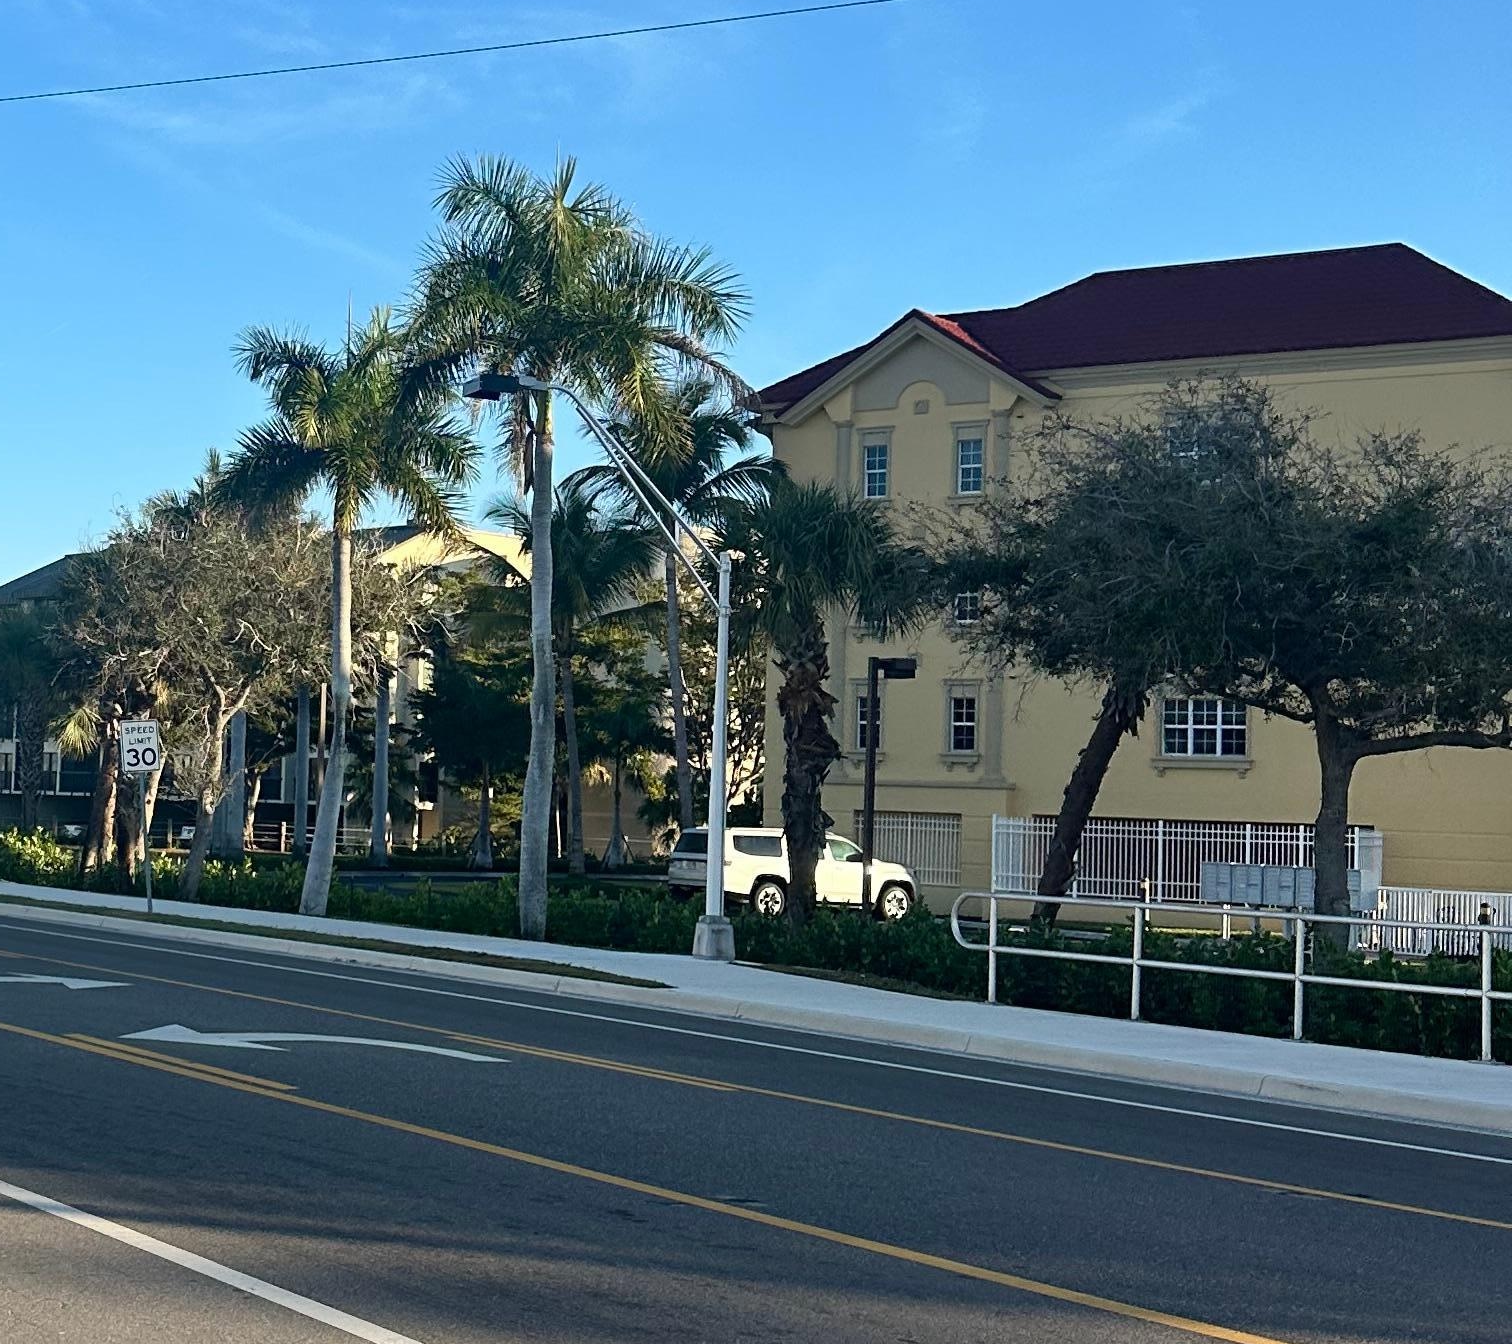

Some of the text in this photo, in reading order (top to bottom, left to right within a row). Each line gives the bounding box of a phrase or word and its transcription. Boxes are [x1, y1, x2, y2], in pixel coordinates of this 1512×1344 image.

[125, 726, 155, 734] SPEED
[129, 737, 152, 745] LIMIT
[127, 748, 156, 766] 30
